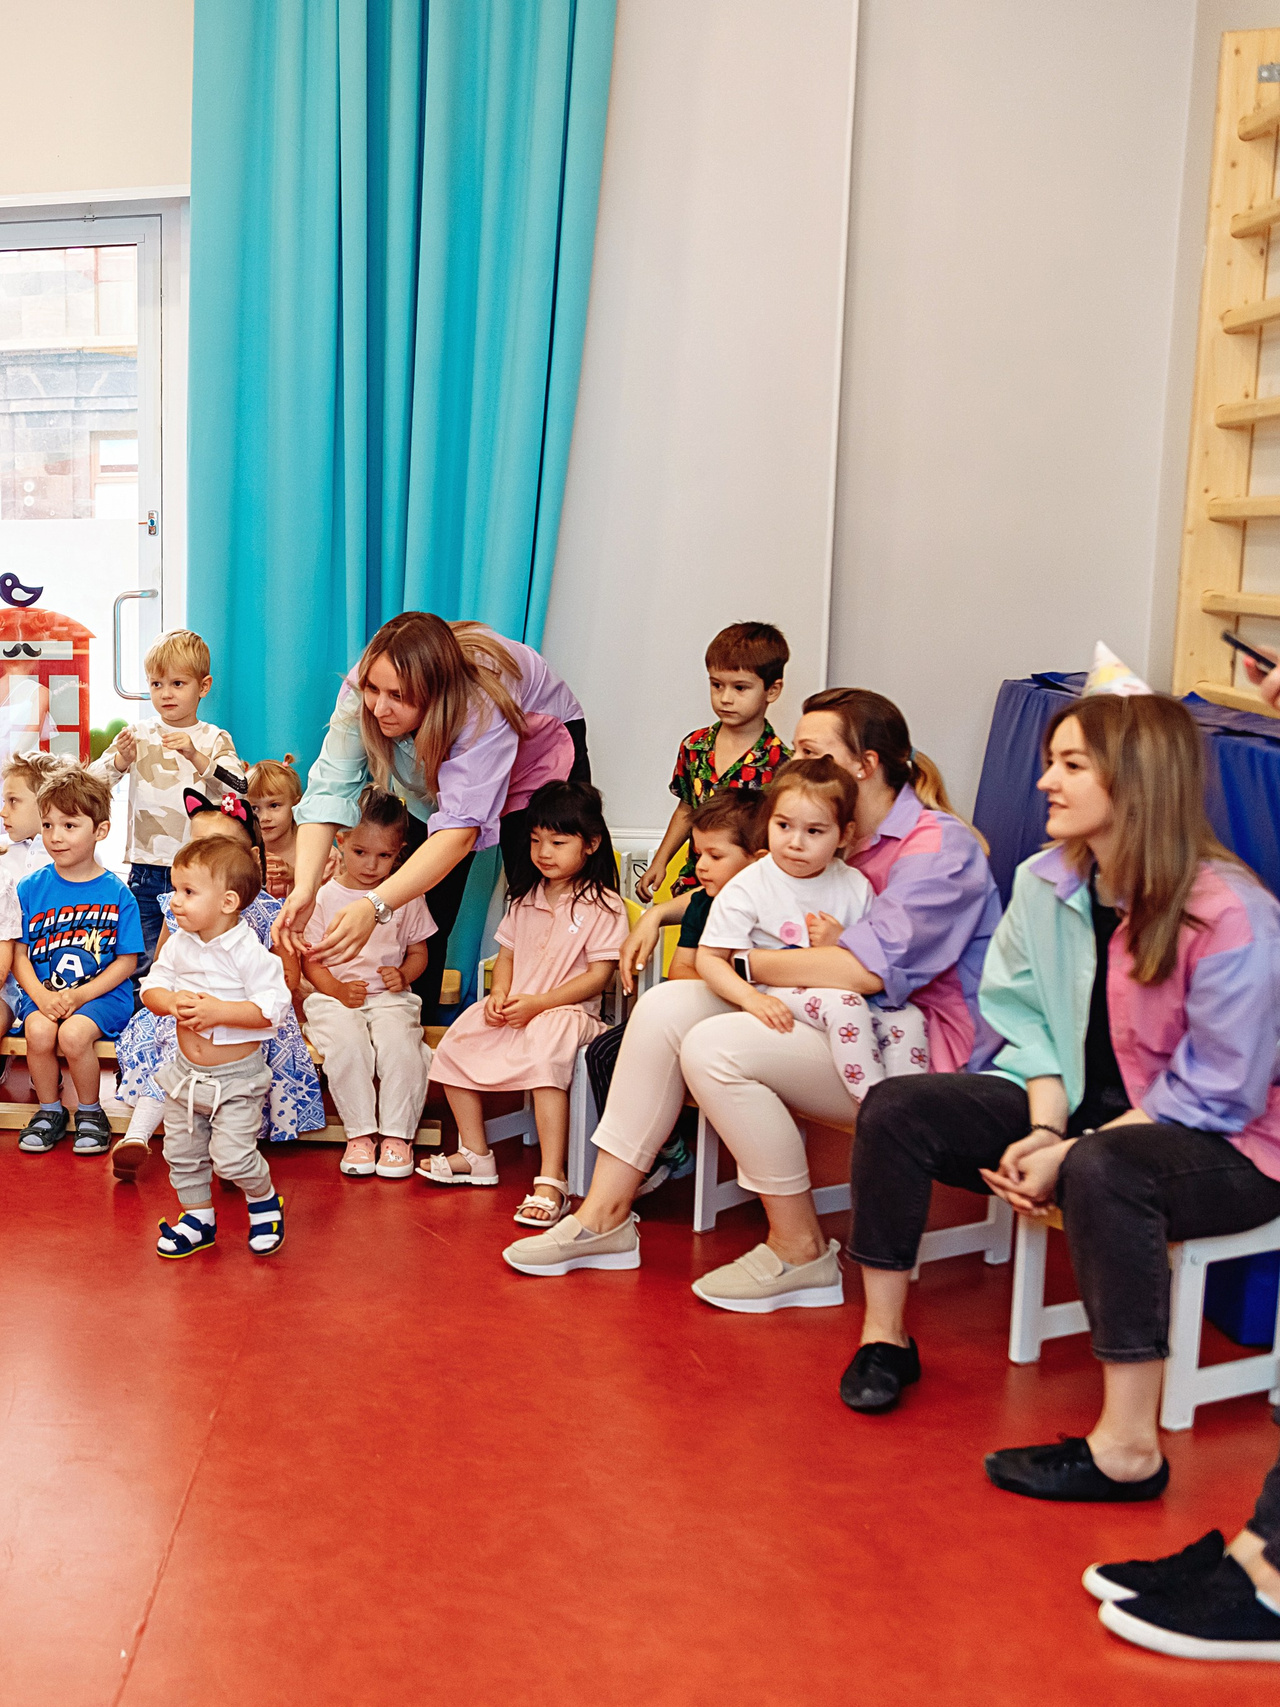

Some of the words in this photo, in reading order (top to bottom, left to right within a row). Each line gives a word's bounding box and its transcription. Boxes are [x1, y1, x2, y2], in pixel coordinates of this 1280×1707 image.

[28, 904, 119, 940] CAPTAIN
[31, 928, 117, 963] AMERCA
[55, 953, 85, 978] A
